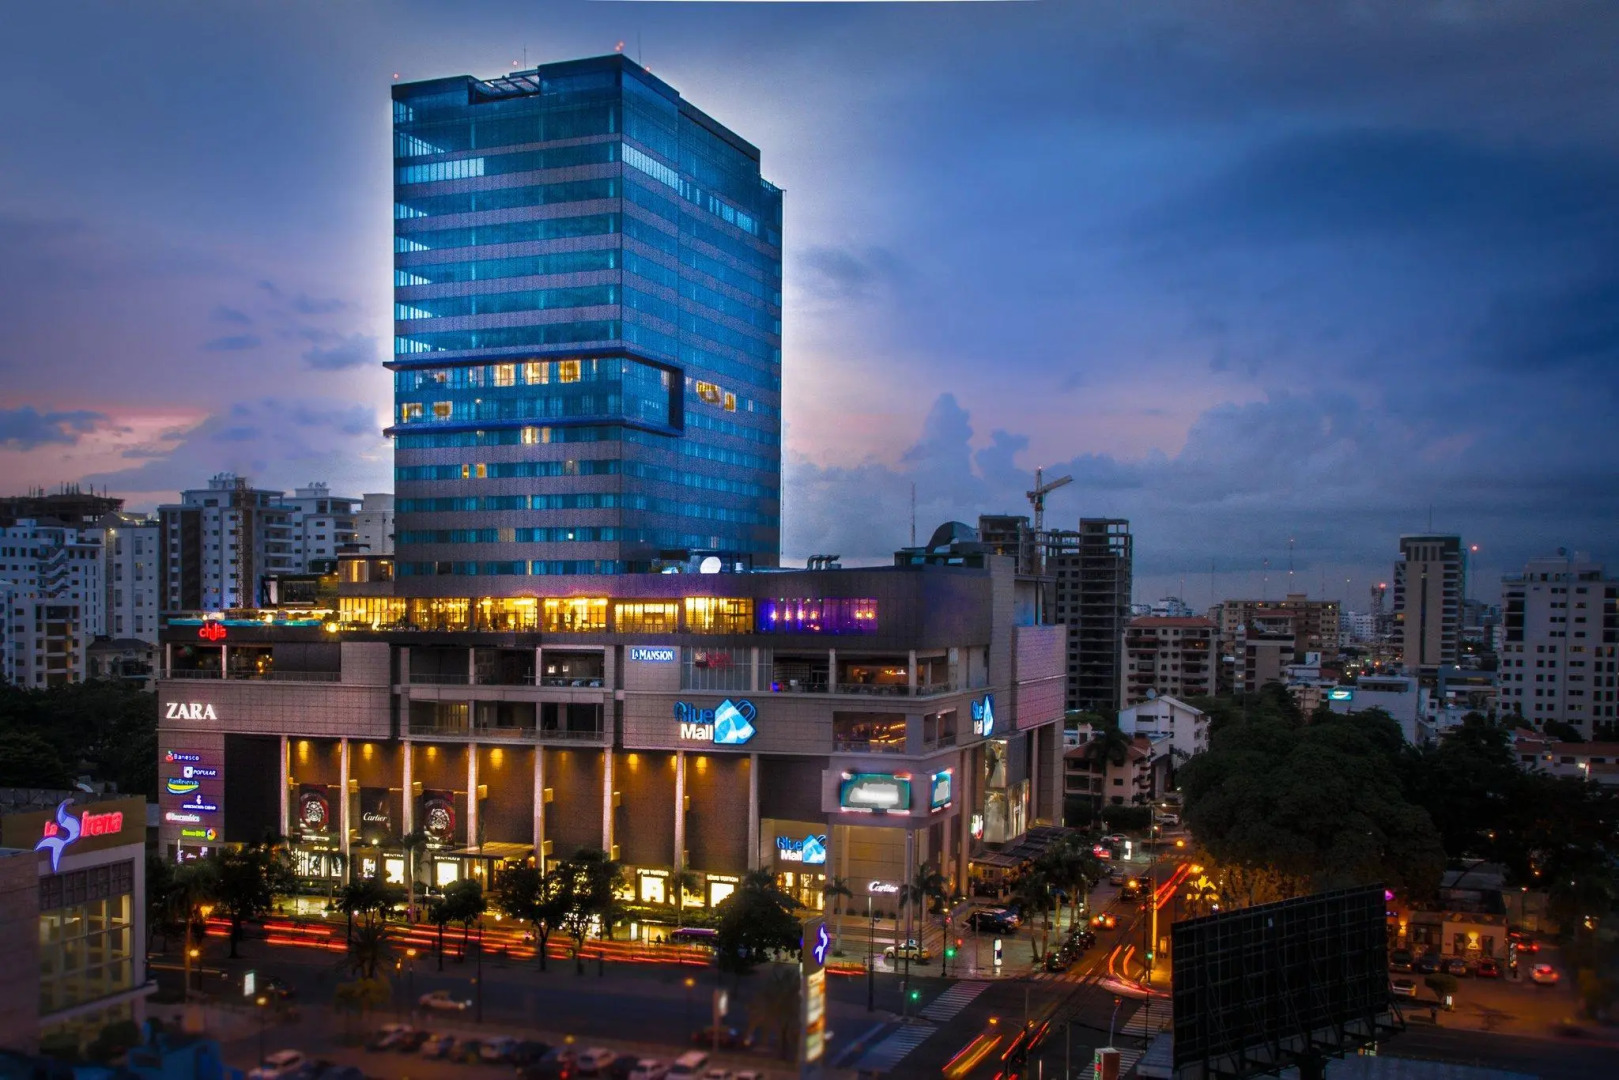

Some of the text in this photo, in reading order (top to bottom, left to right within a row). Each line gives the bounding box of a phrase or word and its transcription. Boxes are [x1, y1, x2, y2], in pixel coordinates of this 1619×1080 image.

[639, 649, 673, 660] MANSION
[166, 703, 217, 719] ZARA
[674, 701, 713, 722] Blue
[681, 724, 713, 740] Mall
[363, 812, 387, 821] Cartier
[777, 836, 803, 850] Blue
[781, 849, 803, 861] Mall
[869, 881, 898, 892] Cartier
